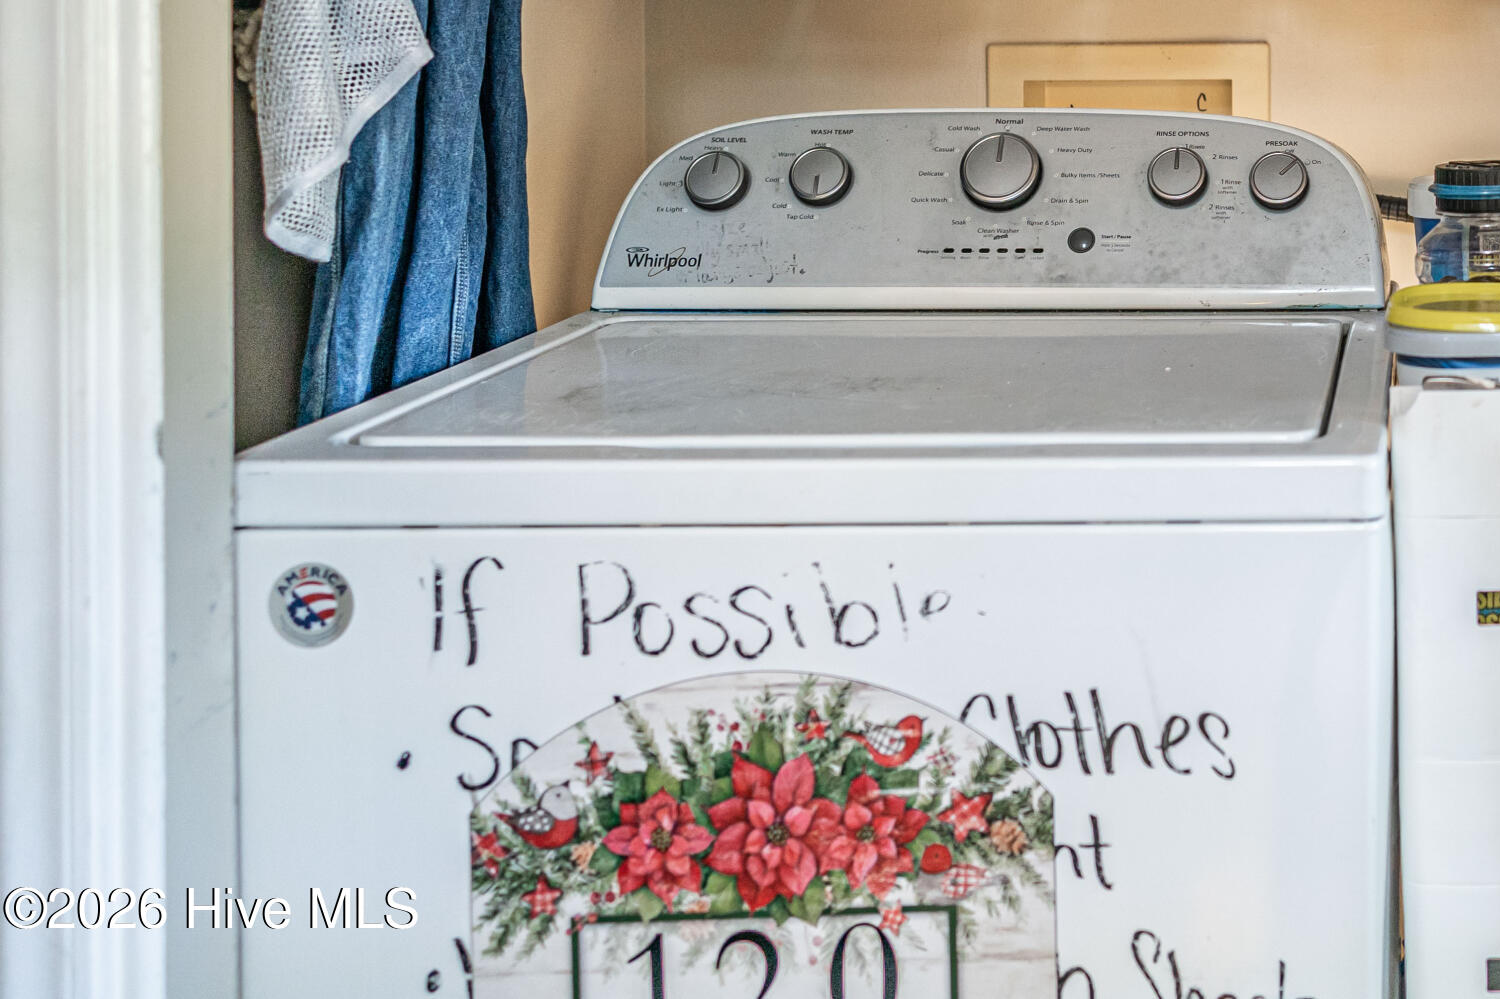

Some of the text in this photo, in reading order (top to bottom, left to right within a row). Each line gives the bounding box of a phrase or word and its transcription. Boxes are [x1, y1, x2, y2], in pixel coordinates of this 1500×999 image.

[665, 206, 683, 214] Light
[1074, 197, 1089, 205] Spin
[627, 252, 702, 271] Whirlpool
[277, 566, 348, 597] AMERICA
[432, 556, 505, 666] If
